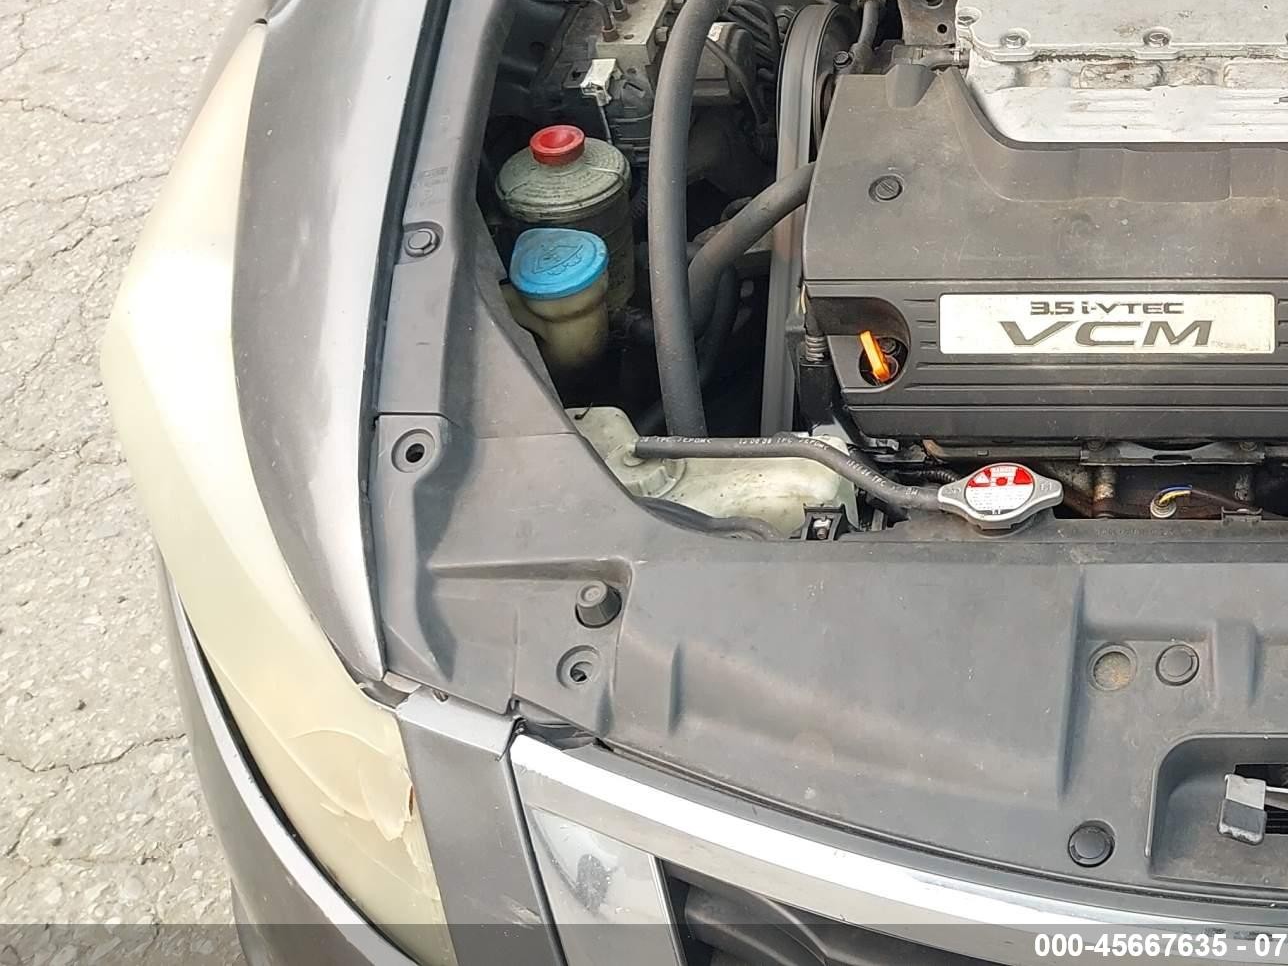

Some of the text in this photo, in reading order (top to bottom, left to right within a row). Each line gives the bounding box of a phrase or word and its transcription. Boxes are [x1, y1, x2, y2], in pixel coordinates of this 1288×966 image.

[1029, 300, 1185, 316] 3.5 i-VTEC
[998, 319, 1214, 348] VCM
